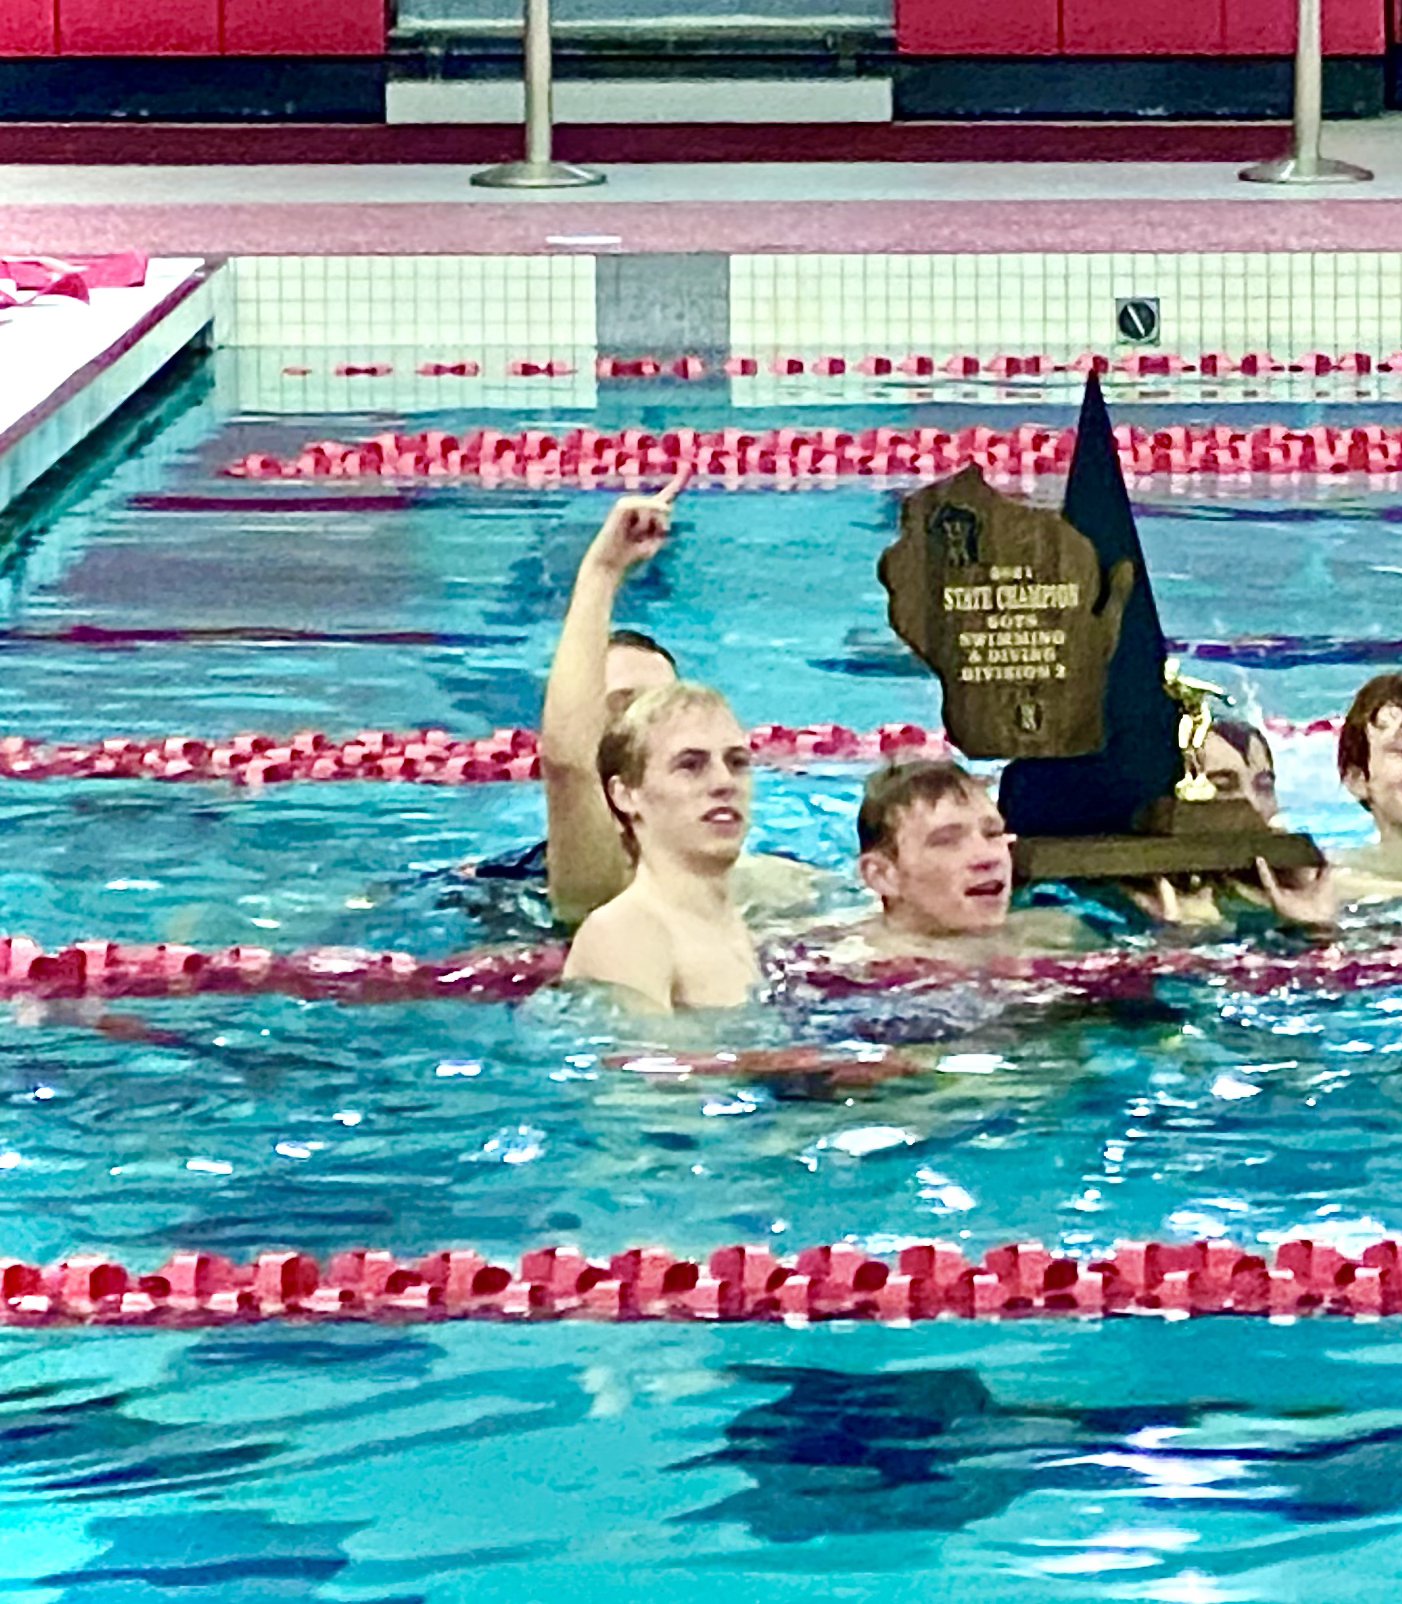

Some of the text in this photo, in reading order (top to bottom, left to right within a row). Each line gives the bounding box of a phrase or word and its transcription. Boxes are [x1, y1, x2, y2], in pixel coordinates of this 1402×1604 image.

[944, 583, 1079, 611] STATE CHAMPION
[959, 630, 1066, 647] SWIMMING
[988, 647, 1057, 663] DIVING
[961, 663, 1067, 682] DIVISION 2
